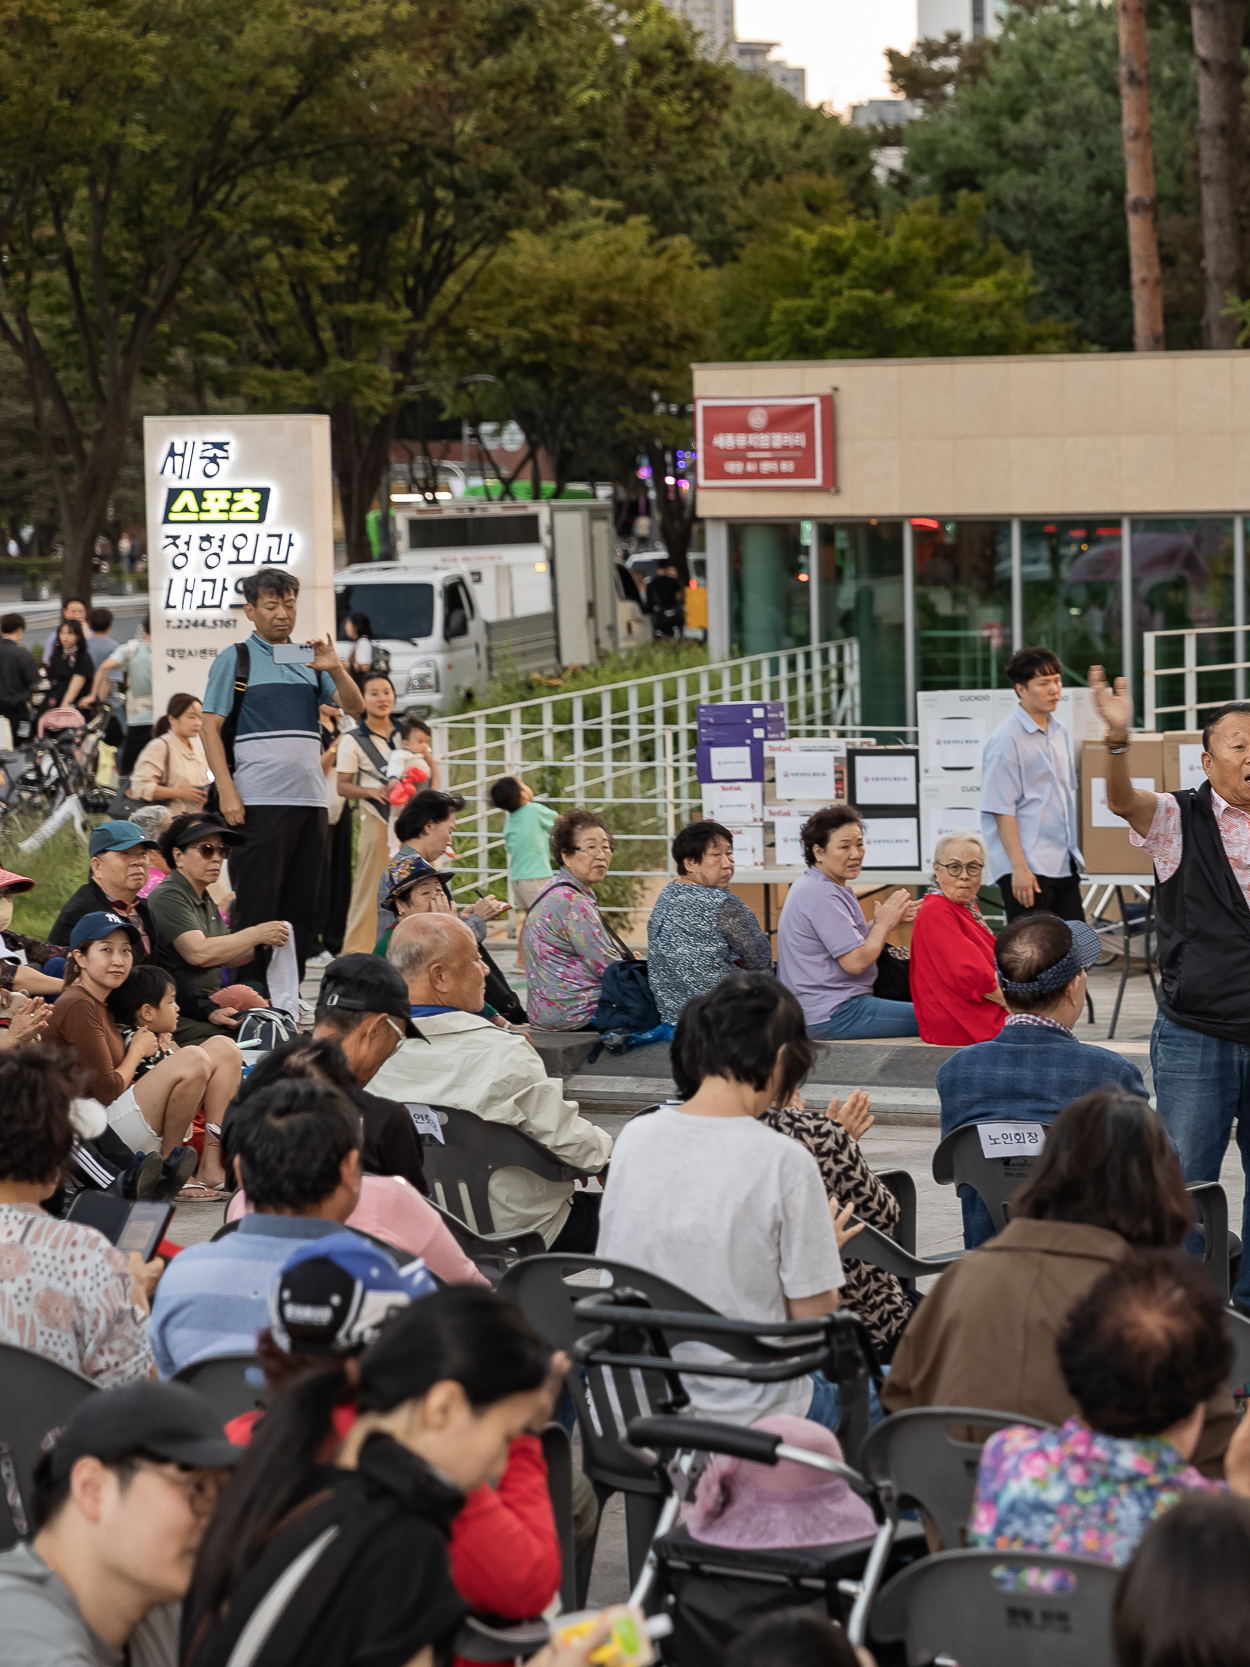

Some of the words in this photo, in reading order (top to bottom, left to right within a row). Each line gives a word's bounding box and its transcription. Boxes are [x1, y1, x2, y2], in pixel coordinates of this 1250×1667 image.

[160, 440, 231, 480] 세종
[168, 489, 262, 522] 스포츠
[162, 532, 296, 570] 정형외과
[988, 1132, 1039, 1145] 노인회장
